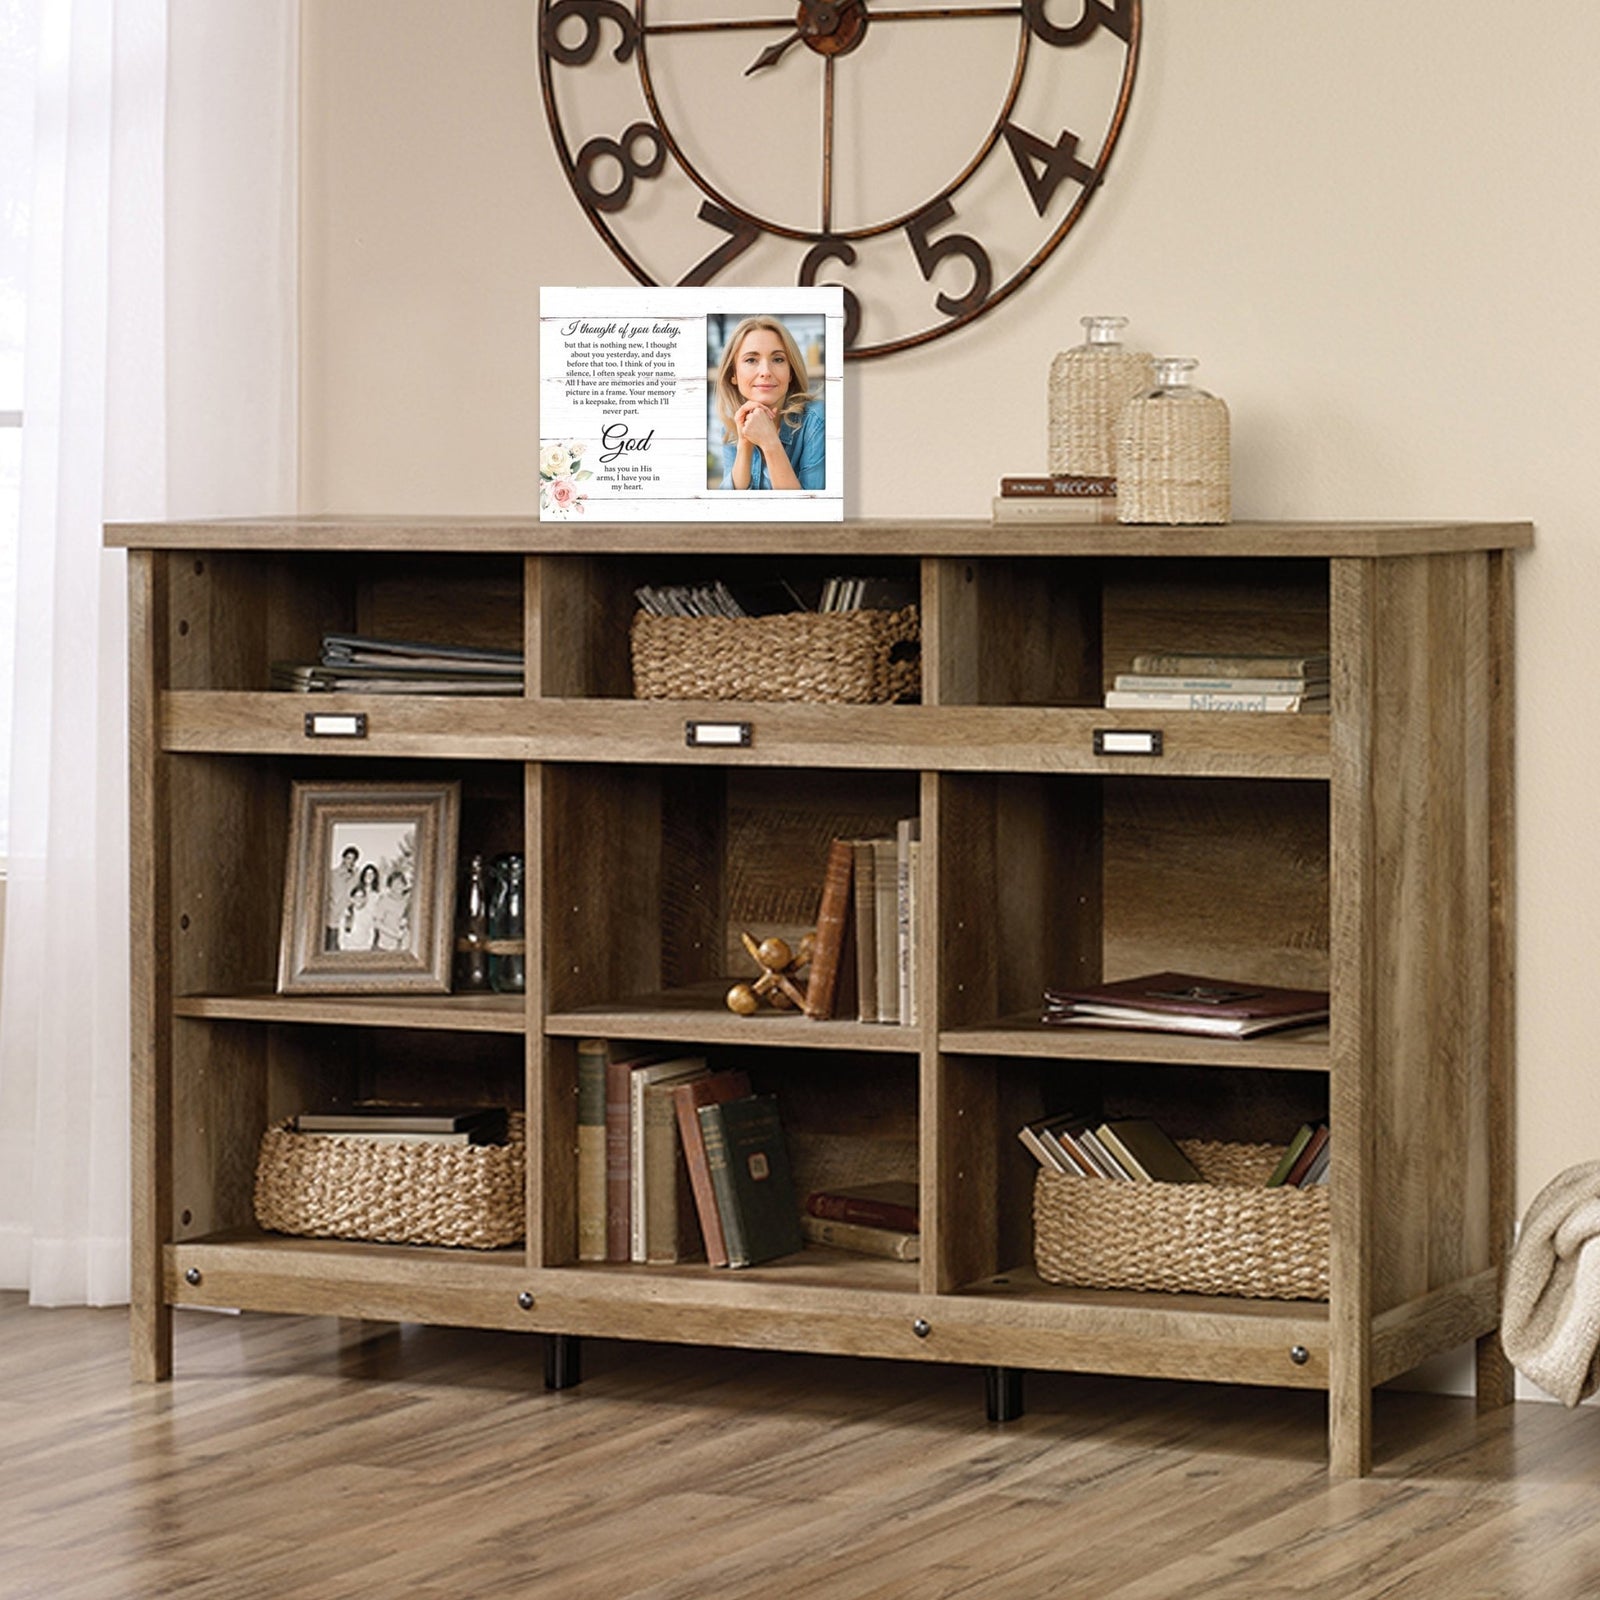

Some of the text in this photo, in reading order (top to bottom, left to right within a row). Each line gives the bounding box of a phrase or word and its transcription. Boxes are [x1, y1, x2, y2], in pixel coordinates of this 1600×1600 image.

[543, 0, 639, 66] 9
[576, 122, 667, 212] 8
[1003, 120, 1098, 216] 4
[677, 200, 759, 287] 7
[902, 199, 992, 318] 5
[560, 320, 682, 339] I thought of you today,
[564, 341, 576, 349] but
[577, 341, 591, 349] that
[592, 341, 599, 349] is
[600, 341, 627, 350] nothing
[645, 341, 649, 349] I
[650, 341, 677, 350] thought
[606, 351, 640, 359] yesterday,
[655, 351, 671, 359] days
[566, 360, 589, 368] before
[590, 360, 604, 368] that
[620, 360, 623, 368] I
[624, 360, 643, 368] think
[644, 360, 652, 368] of
[667, 360, 675, 368] in
[597, 369, 615, 377] often
[616, 370, 636, 378] speak
[565, 389, 590, 397] picture
[585, 398, 618, 407] keepsake,
[623, 408, 639, 416] part.
[599, 423, 655, 463] God
[638, 475, 652, 483] you
